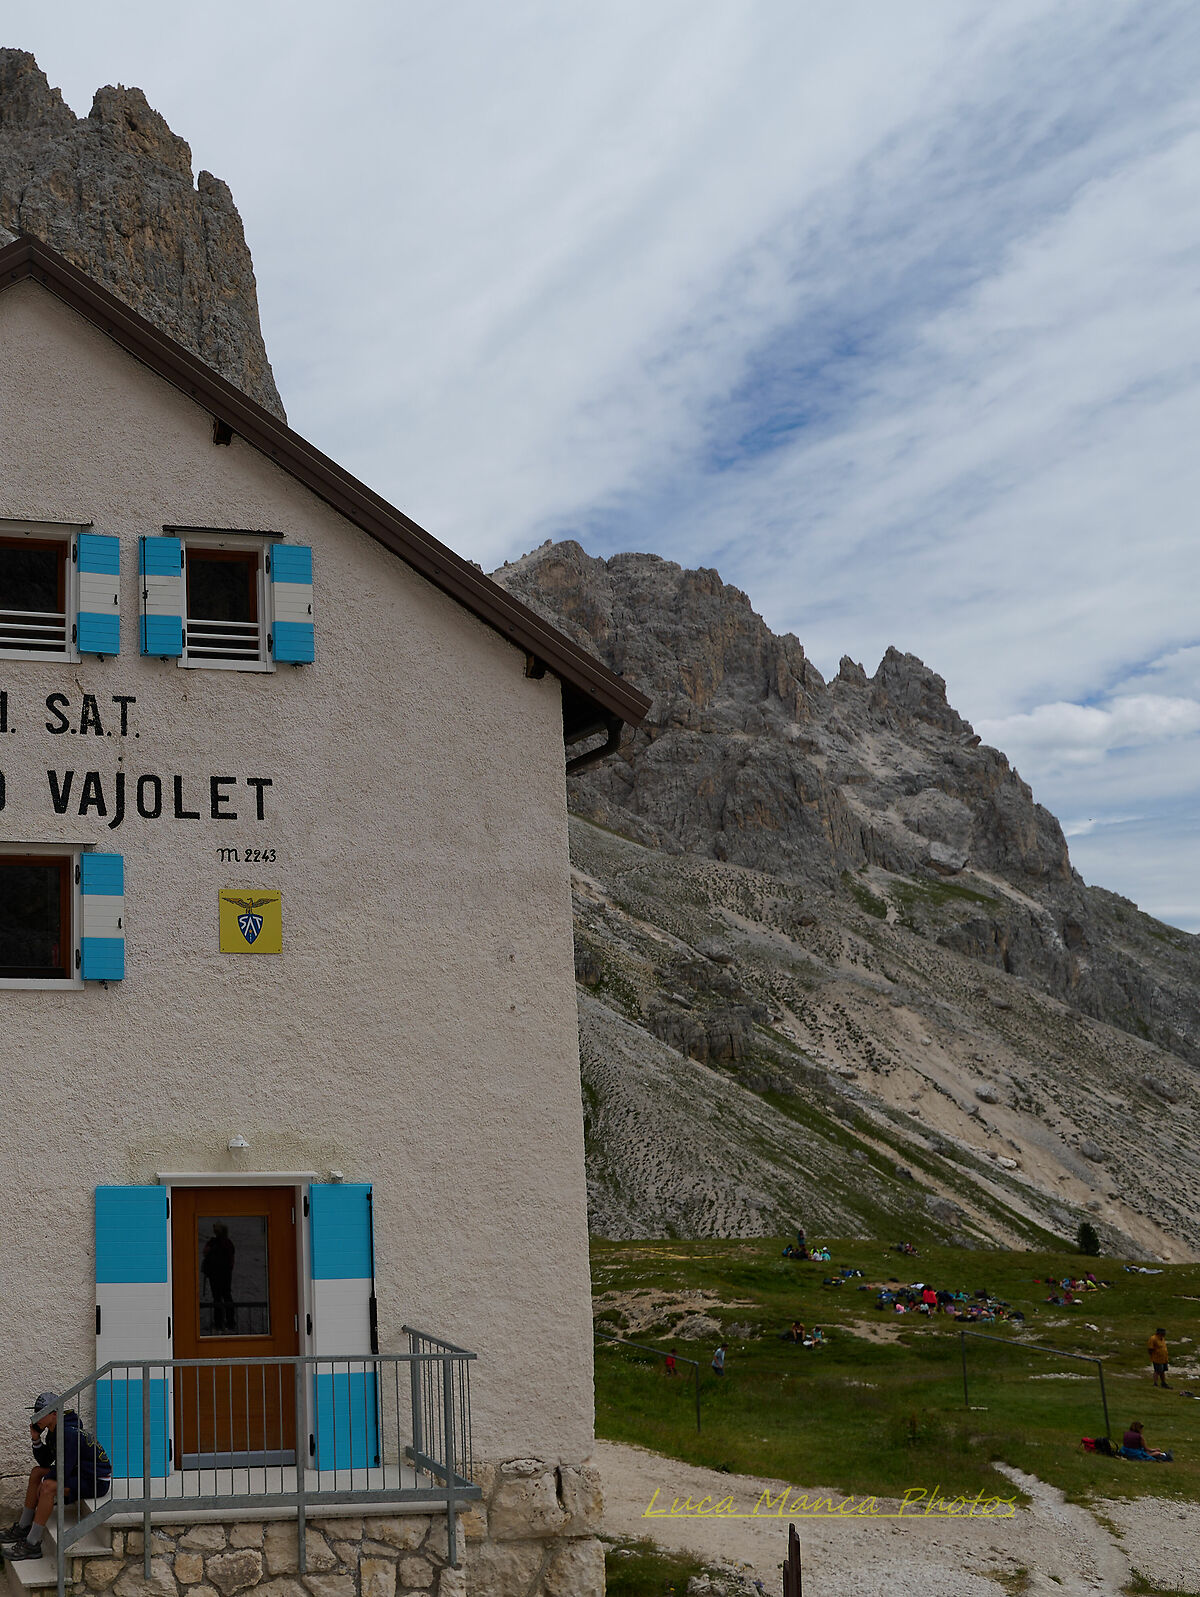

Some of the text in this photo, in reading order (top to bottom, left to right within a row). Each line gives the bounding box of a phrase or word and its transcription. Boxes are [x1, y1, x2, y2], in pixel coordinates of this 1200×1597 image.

[45, 692, 141, 738] S.A.T.
[46, 757, 273, 830] VAJOLET
[244, 848, 277, 863] 2243
[238, 915, 263, 937] SAT
